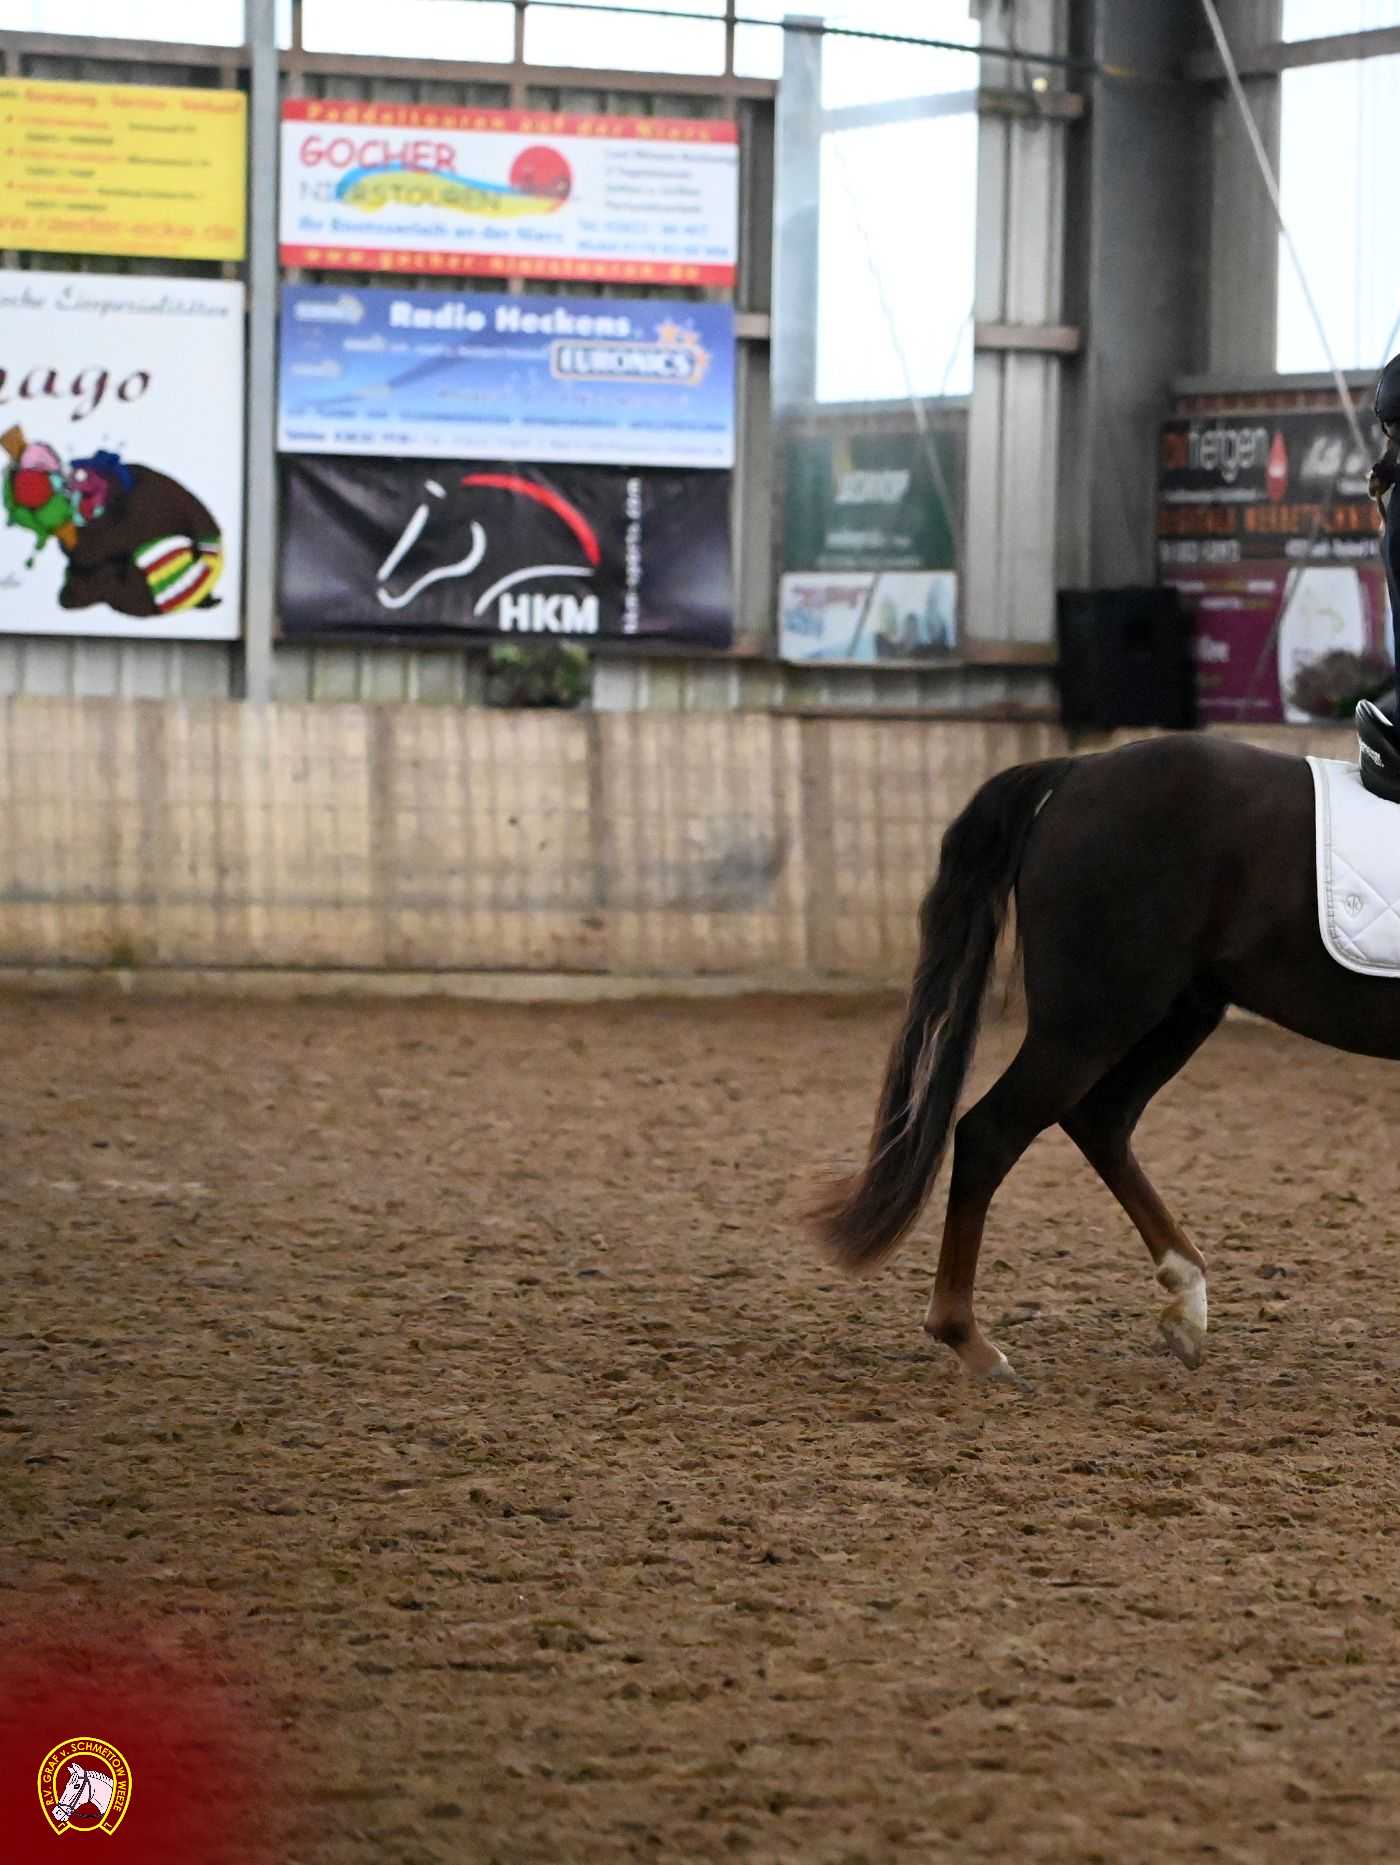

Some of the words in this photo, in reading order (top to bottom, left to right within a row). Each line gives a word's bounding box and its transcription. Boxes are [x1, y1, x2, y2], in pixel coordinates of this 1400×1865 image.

[300, 133, 458, 174] GOCHER
[389, 301, 487, 331] Radio
[499, 592, 599, 634] HKM
